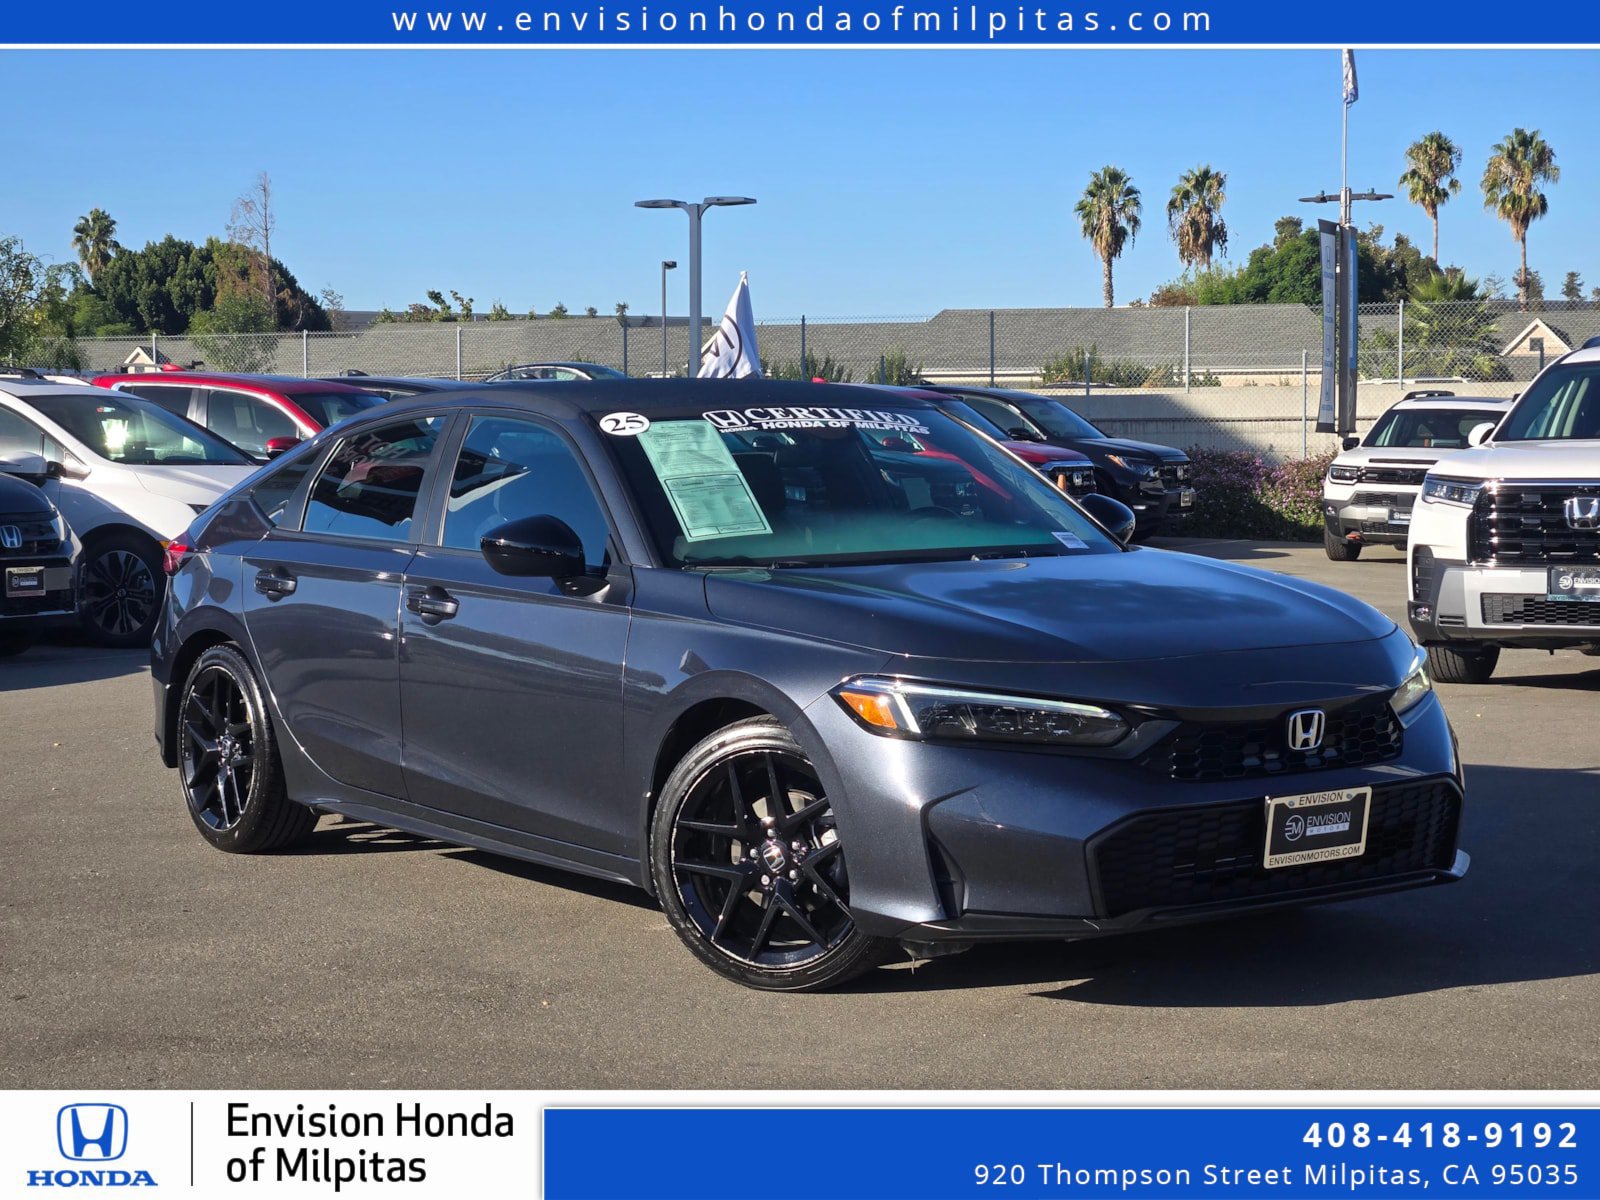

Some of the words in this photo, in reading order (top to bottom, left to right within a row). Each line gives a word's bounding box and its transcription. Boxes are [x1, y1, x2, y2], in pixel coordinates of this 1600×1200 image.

[604, 415, 645, 432] 25
[744, 407, 921, 426] CERTIFIED
[719, 426, 758, 434] HONDA
[762, 419, 823, 430] HONDA
[828, 420, 851, 429] OF
[855, 421, 931, 435] MILPITAS
[1298, 791, 1344, 806] ENVISION
[1306, 811, 1352, 828] ENVISION
[1268, 845, 1361, 866] ENVISIONMOTORS.COM
